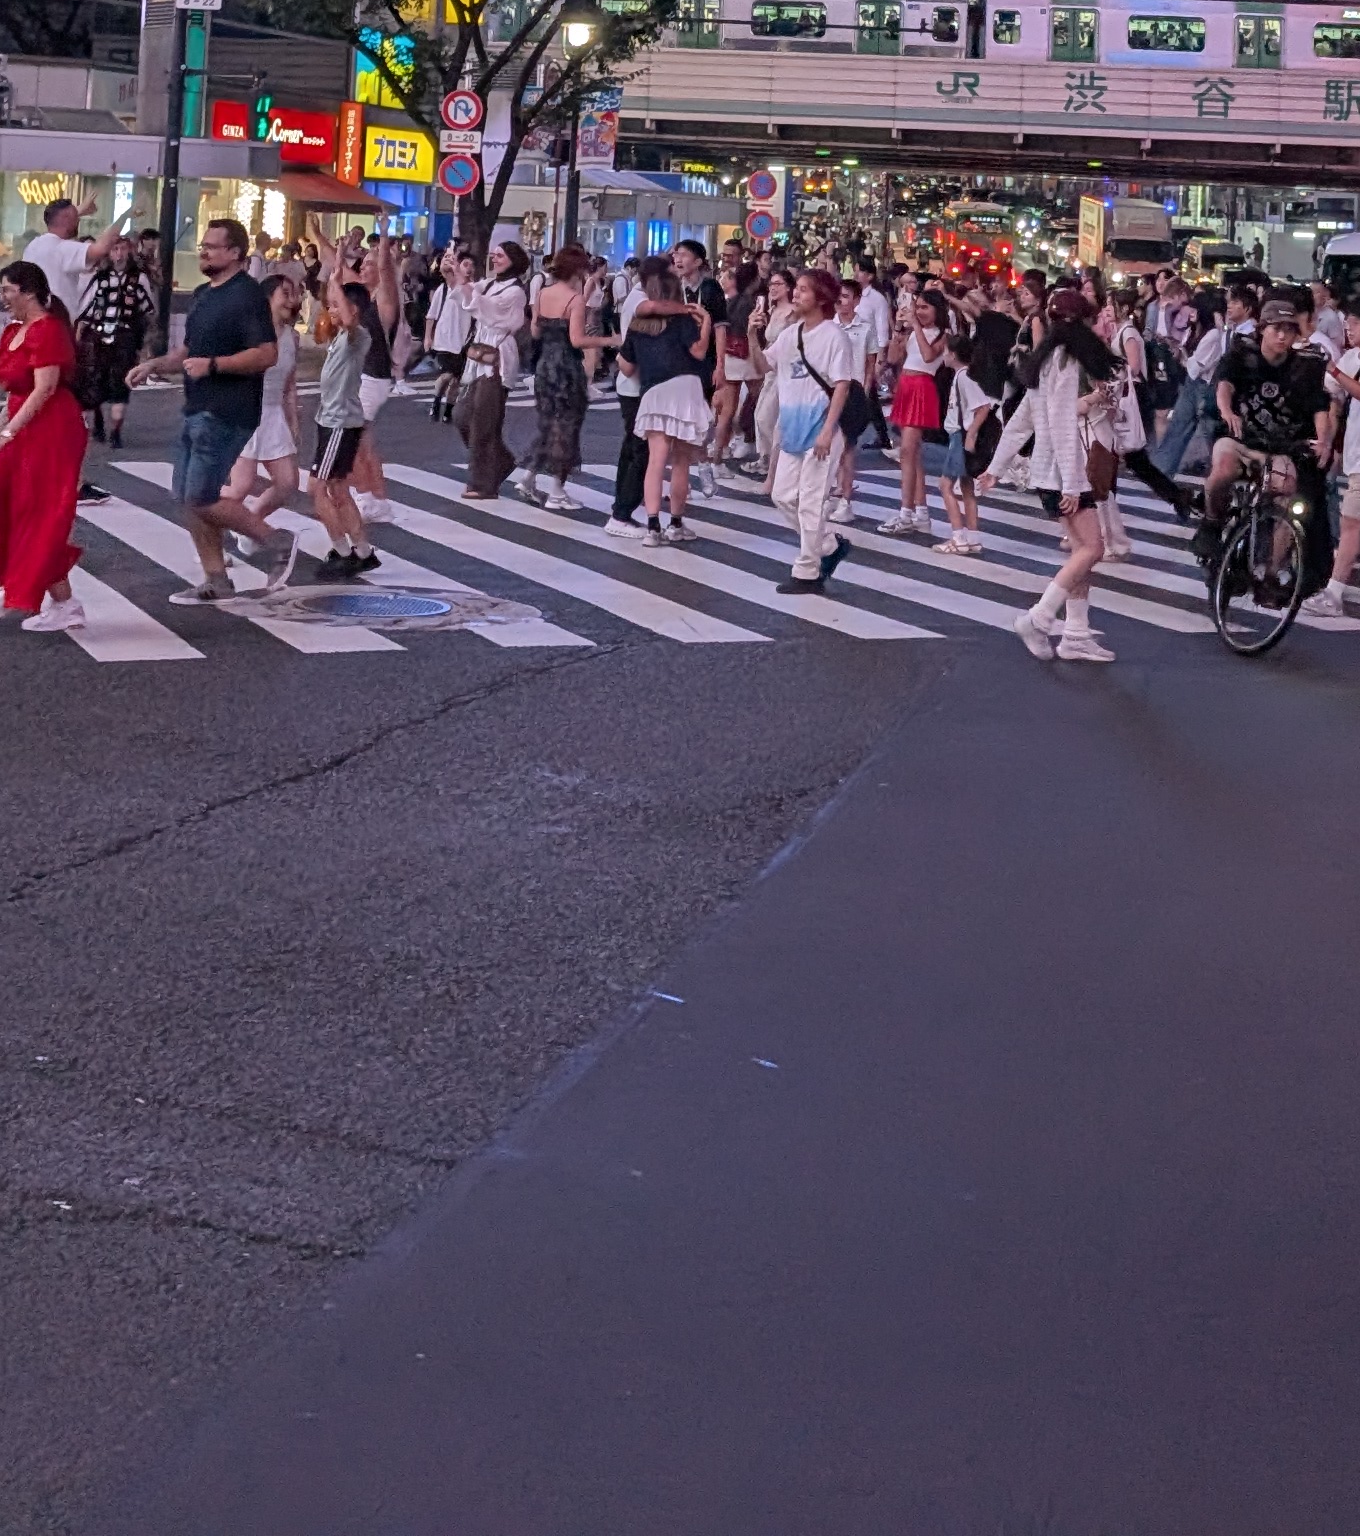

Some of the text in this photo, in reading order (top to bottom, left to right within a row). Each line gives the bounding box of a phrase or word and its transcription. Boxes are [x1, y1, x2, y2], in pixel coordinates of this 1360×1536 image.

[935, 71, 981, 97] JR
[222, 123, 245, 138] GINZA
[373, 134, 419, 172] プロミス
